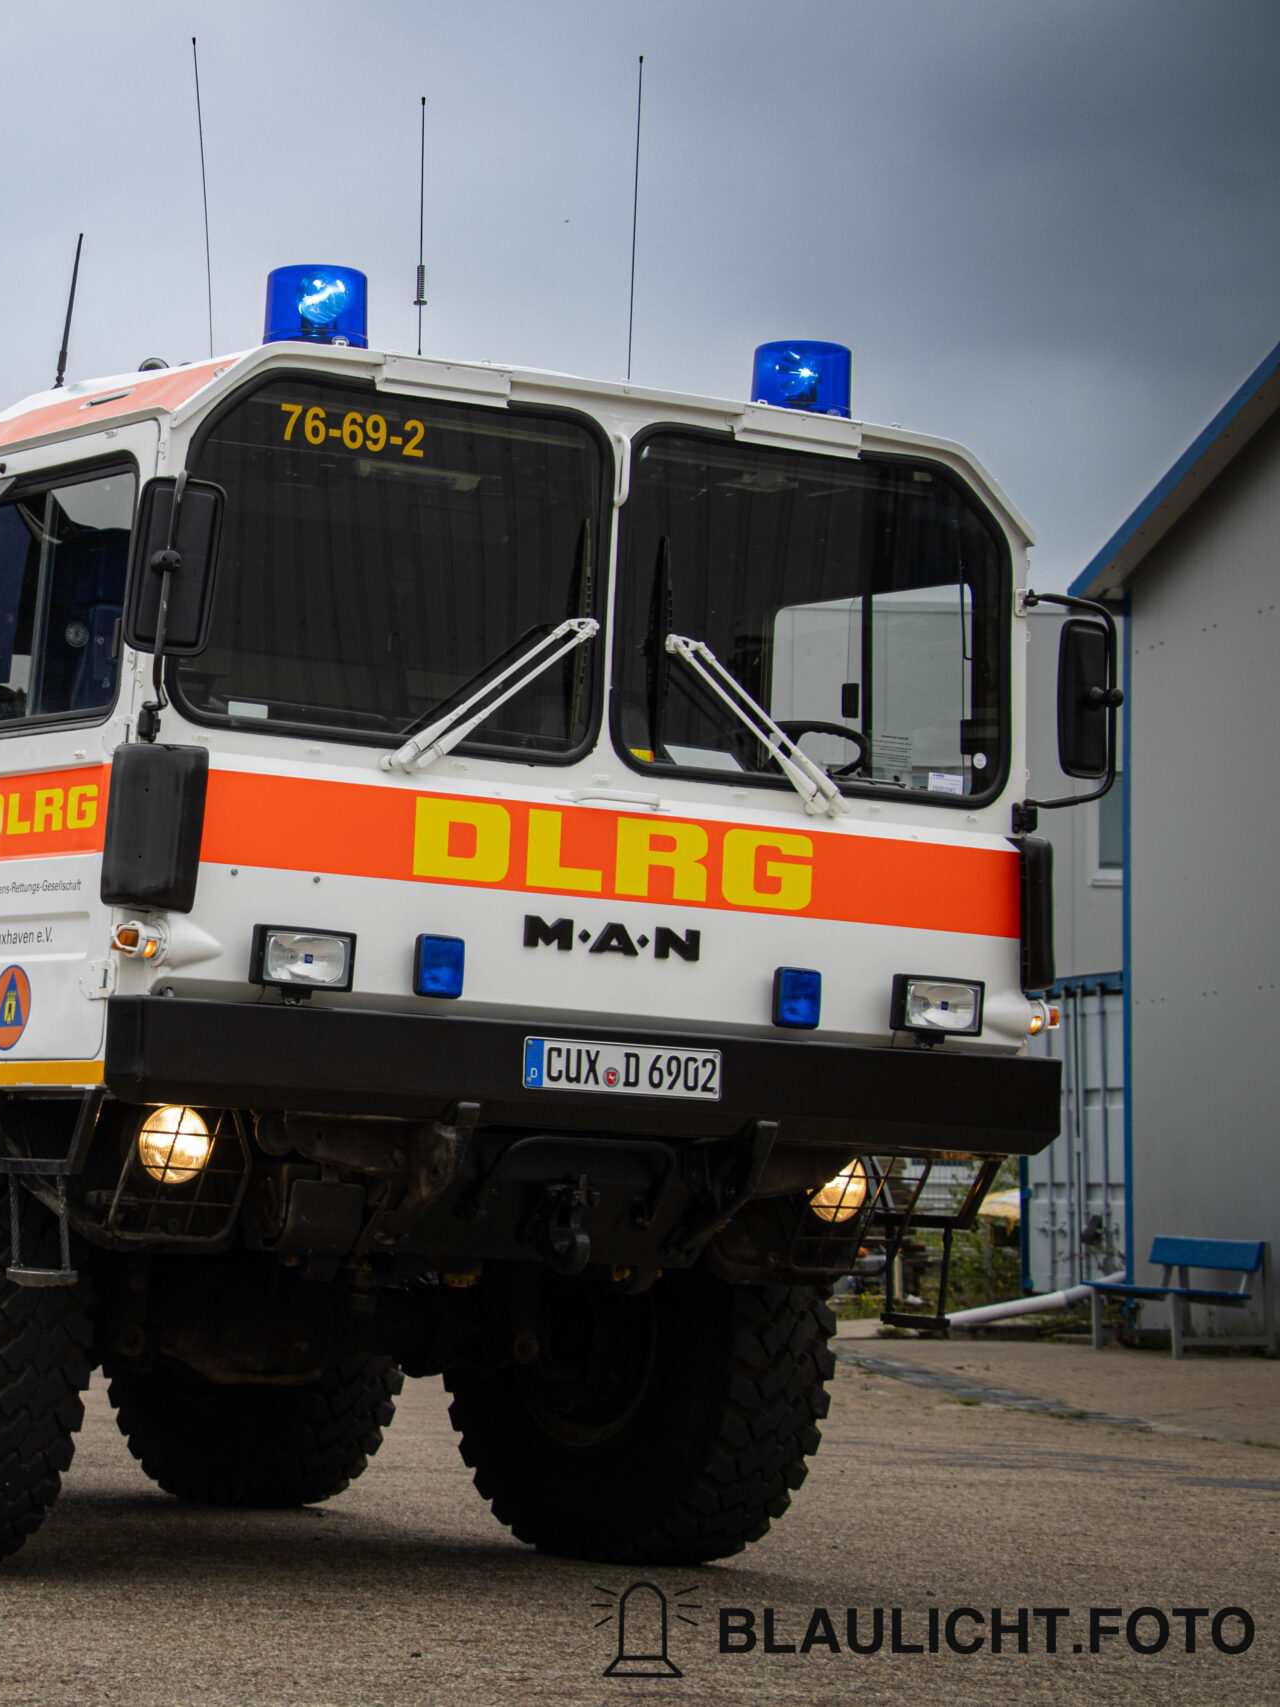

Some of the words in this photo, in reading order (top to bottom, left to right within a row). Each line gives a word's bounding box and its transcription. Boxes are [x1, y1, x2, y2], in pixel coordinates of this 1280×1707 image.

[281, 403, 425, 458] 76-69-2
[412, 796, 814, 911] DLRG
[36, 926, 53, 943] e.V.
[530, 1067, 538, 1079] D
[546, 1047, 601, 1086] CUX
[622, 1052, 640, 1088] D
[648, 1054, 718, 1092] 6902
